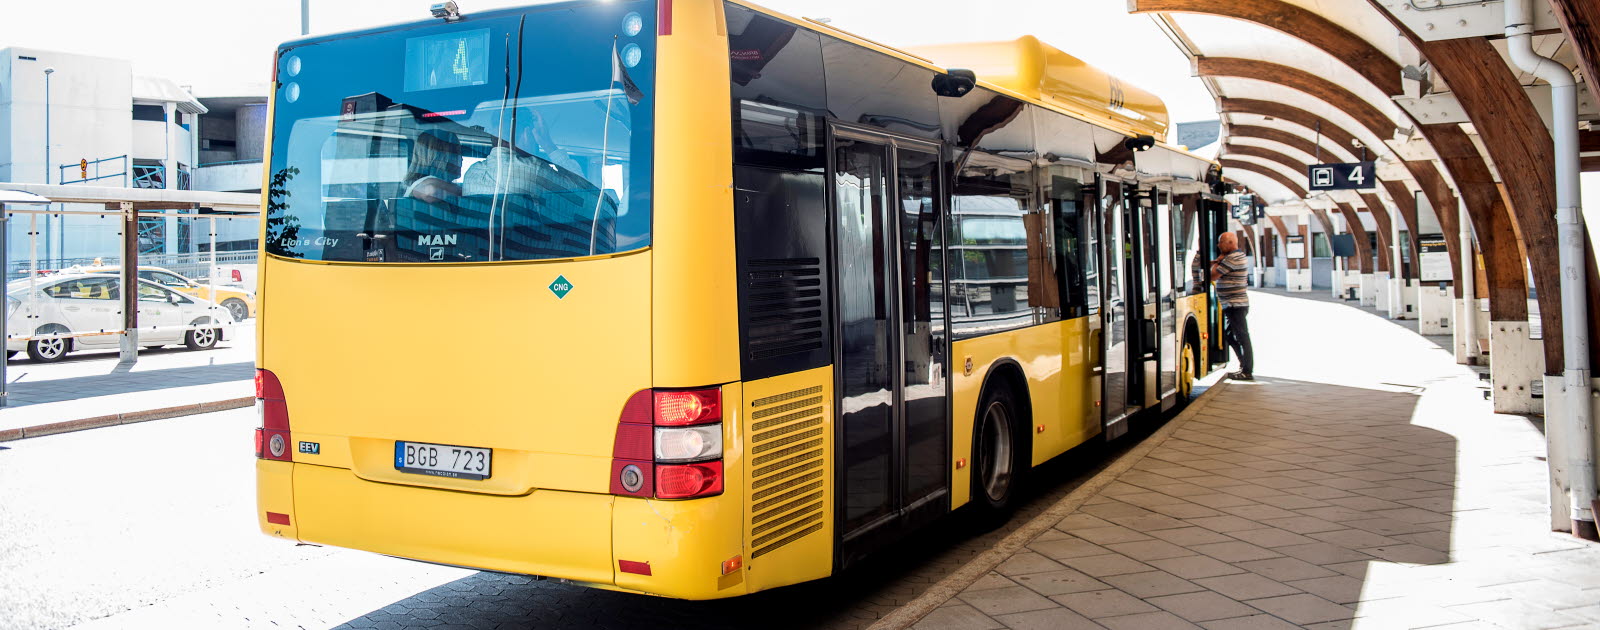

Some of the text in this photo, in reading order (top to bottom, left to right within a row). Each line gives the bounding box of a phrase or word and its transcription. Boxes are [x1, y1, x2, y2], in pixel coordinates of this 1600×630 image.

[452, 40, 469, 80] 4
[1347, 165, 1365, 185] 4
[280, 236, 339, 248] Lion's City
[418, 234, 458, 246] MAN
[553, 283, 569, 291] CNG
[299, 441, 319, 453] EEV
[406, 445, 485, 471] BGB 723
